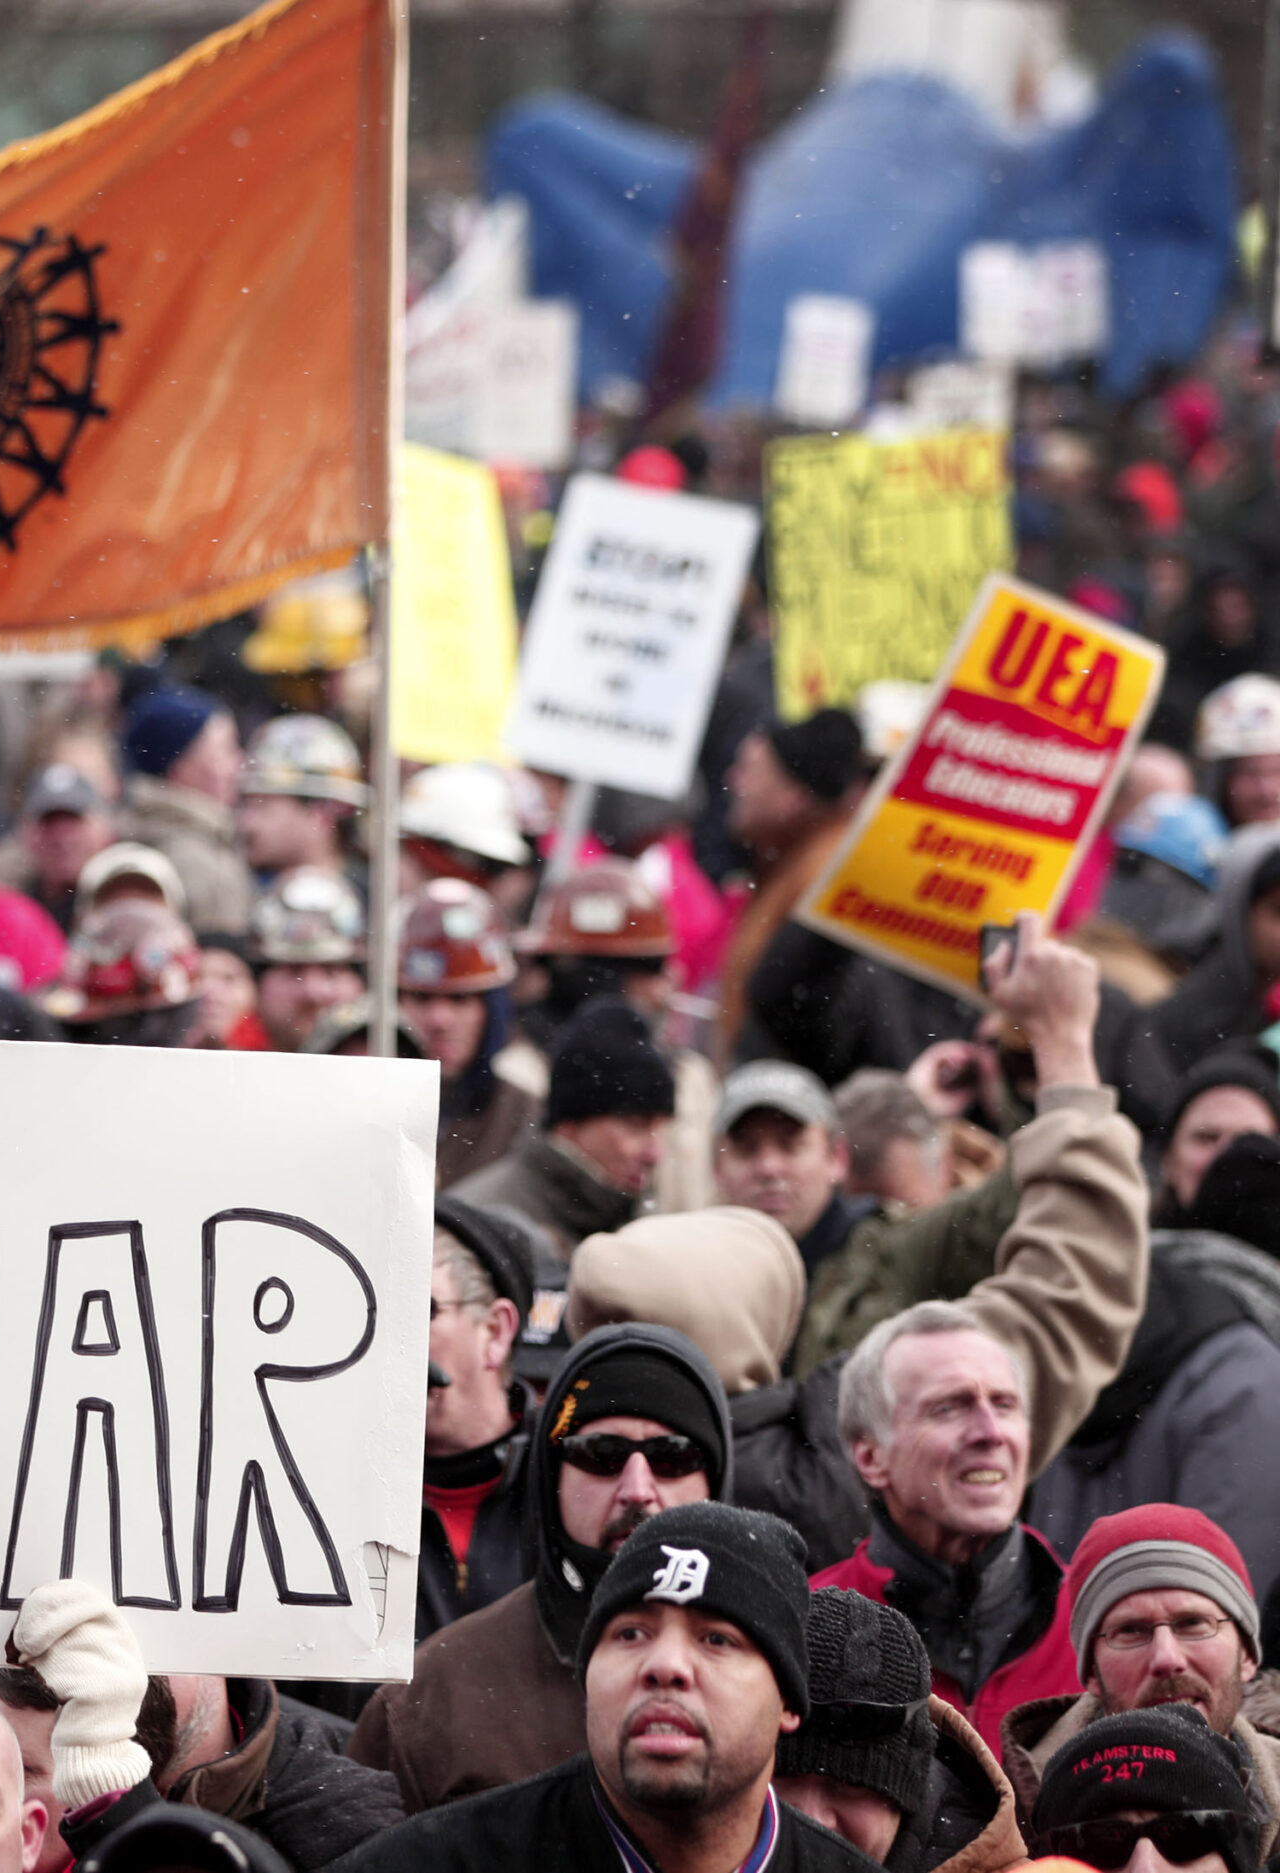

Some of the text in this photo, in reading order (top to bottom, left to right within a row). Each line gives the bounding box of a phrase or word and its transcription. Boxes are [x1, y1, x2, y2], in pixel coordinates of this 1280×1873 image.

[987, 609, 1118, 727] UEA
[926, 710, 1108, 786] Professional
[923, 753, 1080, 824] Educators
[909, 821, 1036, 884] Serving
[1072, 1744, 1178, 1776] TEAMSTERS
[1101, 1761, 1146, 1784] 247
